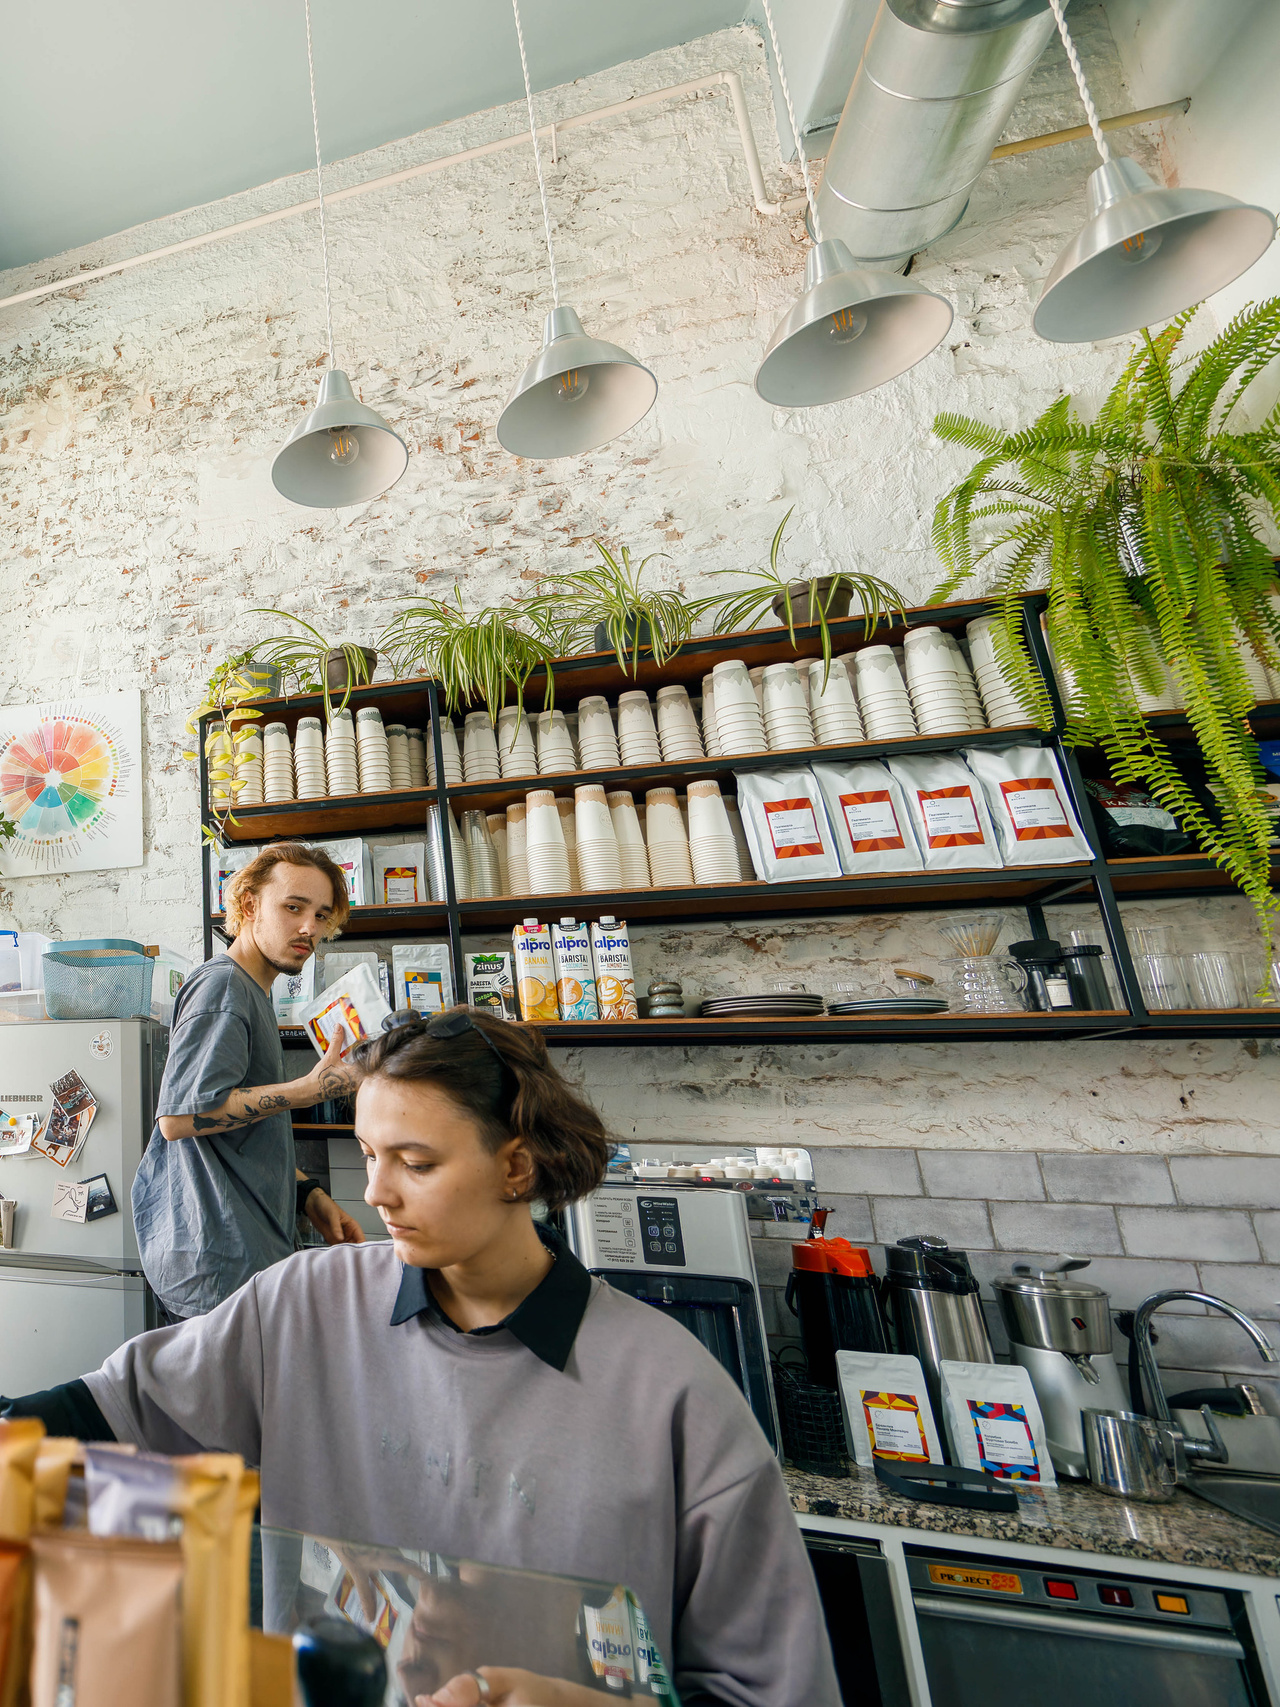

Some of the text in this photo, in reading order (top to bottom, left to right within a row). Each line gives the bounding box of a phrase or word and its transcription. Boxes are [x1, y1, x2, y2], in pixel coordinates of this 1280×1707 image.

[518, 937, 550, 953] alpro
[555, 936, 588, 951] alpro
[595, 935, 628, 951] alpro
[524, 957, 548, 965] BANANA
[561, 953, 587, 963] BARISTA
[600, 953, 627, 963] BARISTA
[476, 962, 502, 970] zinus
[0, 1094, 43, 1102] LIEBHERR
